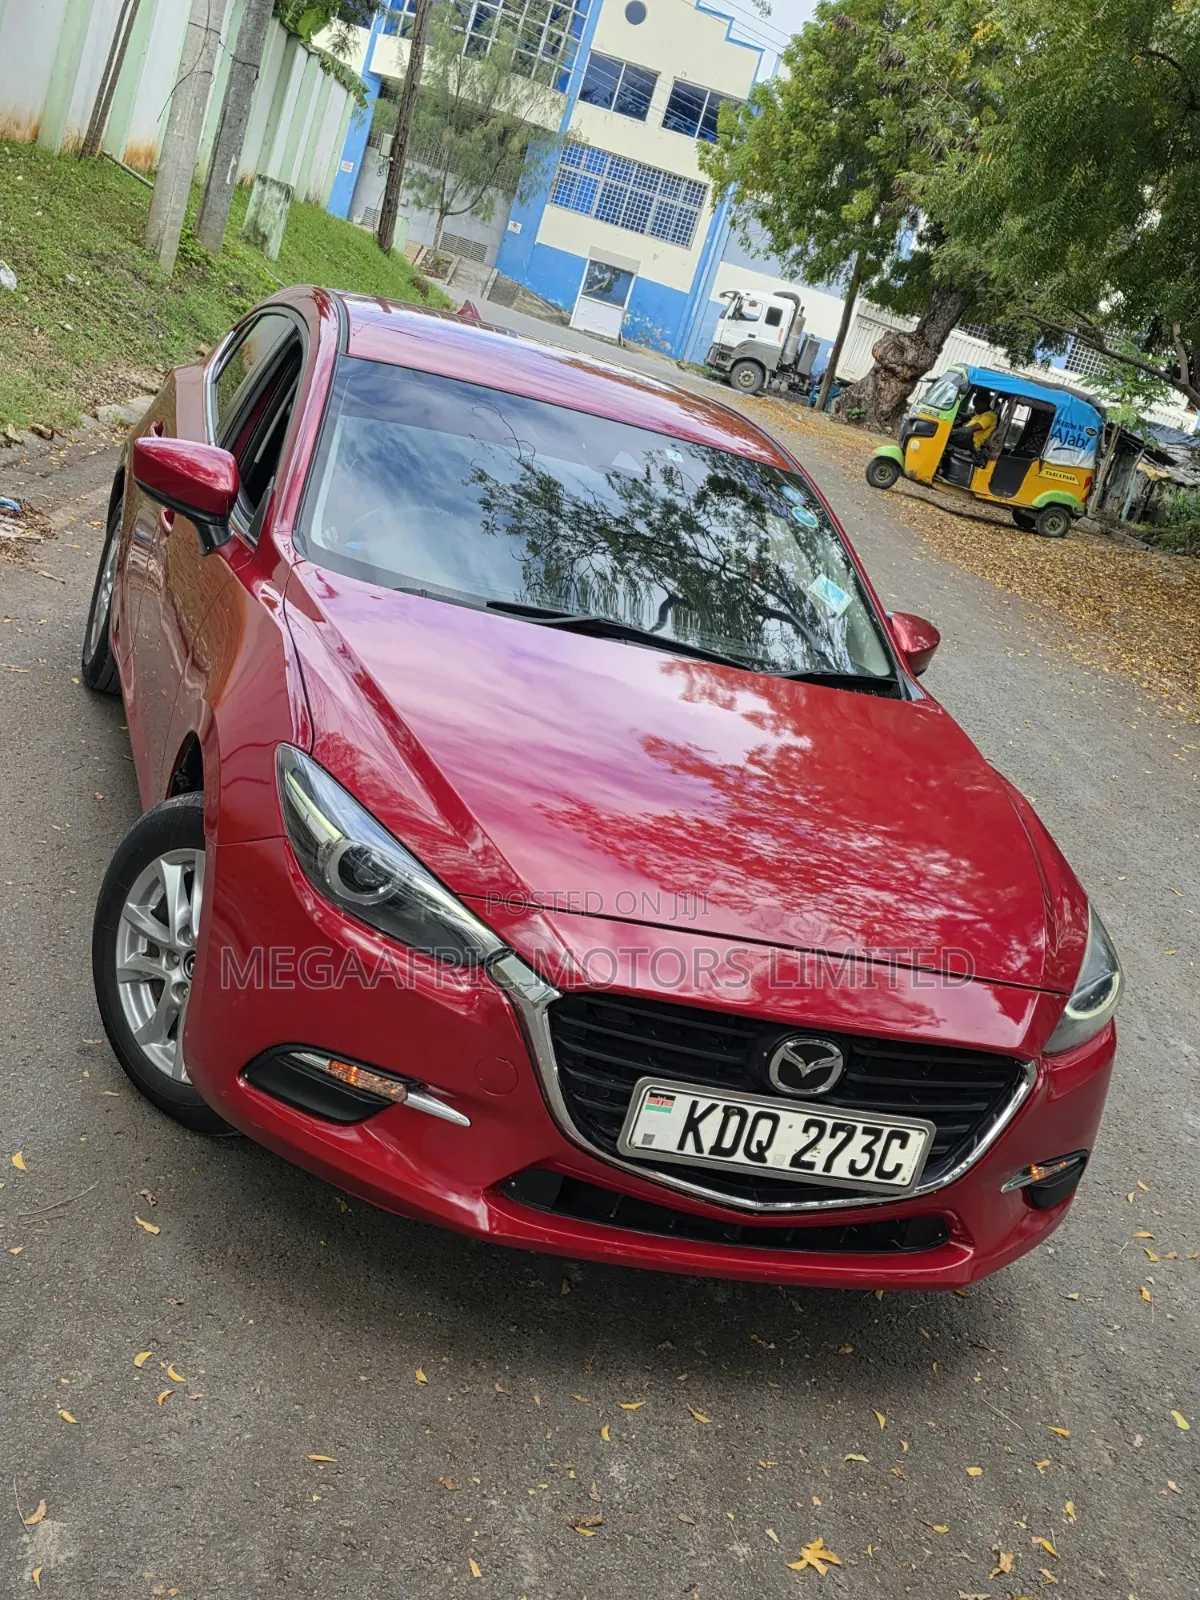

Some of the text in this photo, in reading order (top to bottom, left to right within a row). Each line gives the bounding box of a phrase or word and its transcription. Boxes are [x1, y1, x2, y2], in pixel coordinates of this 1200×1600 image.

[1045, 470, 1058, 478] TAXI
[1062, 474, 1076, 482] PASS
[677, 1099, 781, 1165] KDQ
[789, 1118, 911, 1181] 273C
